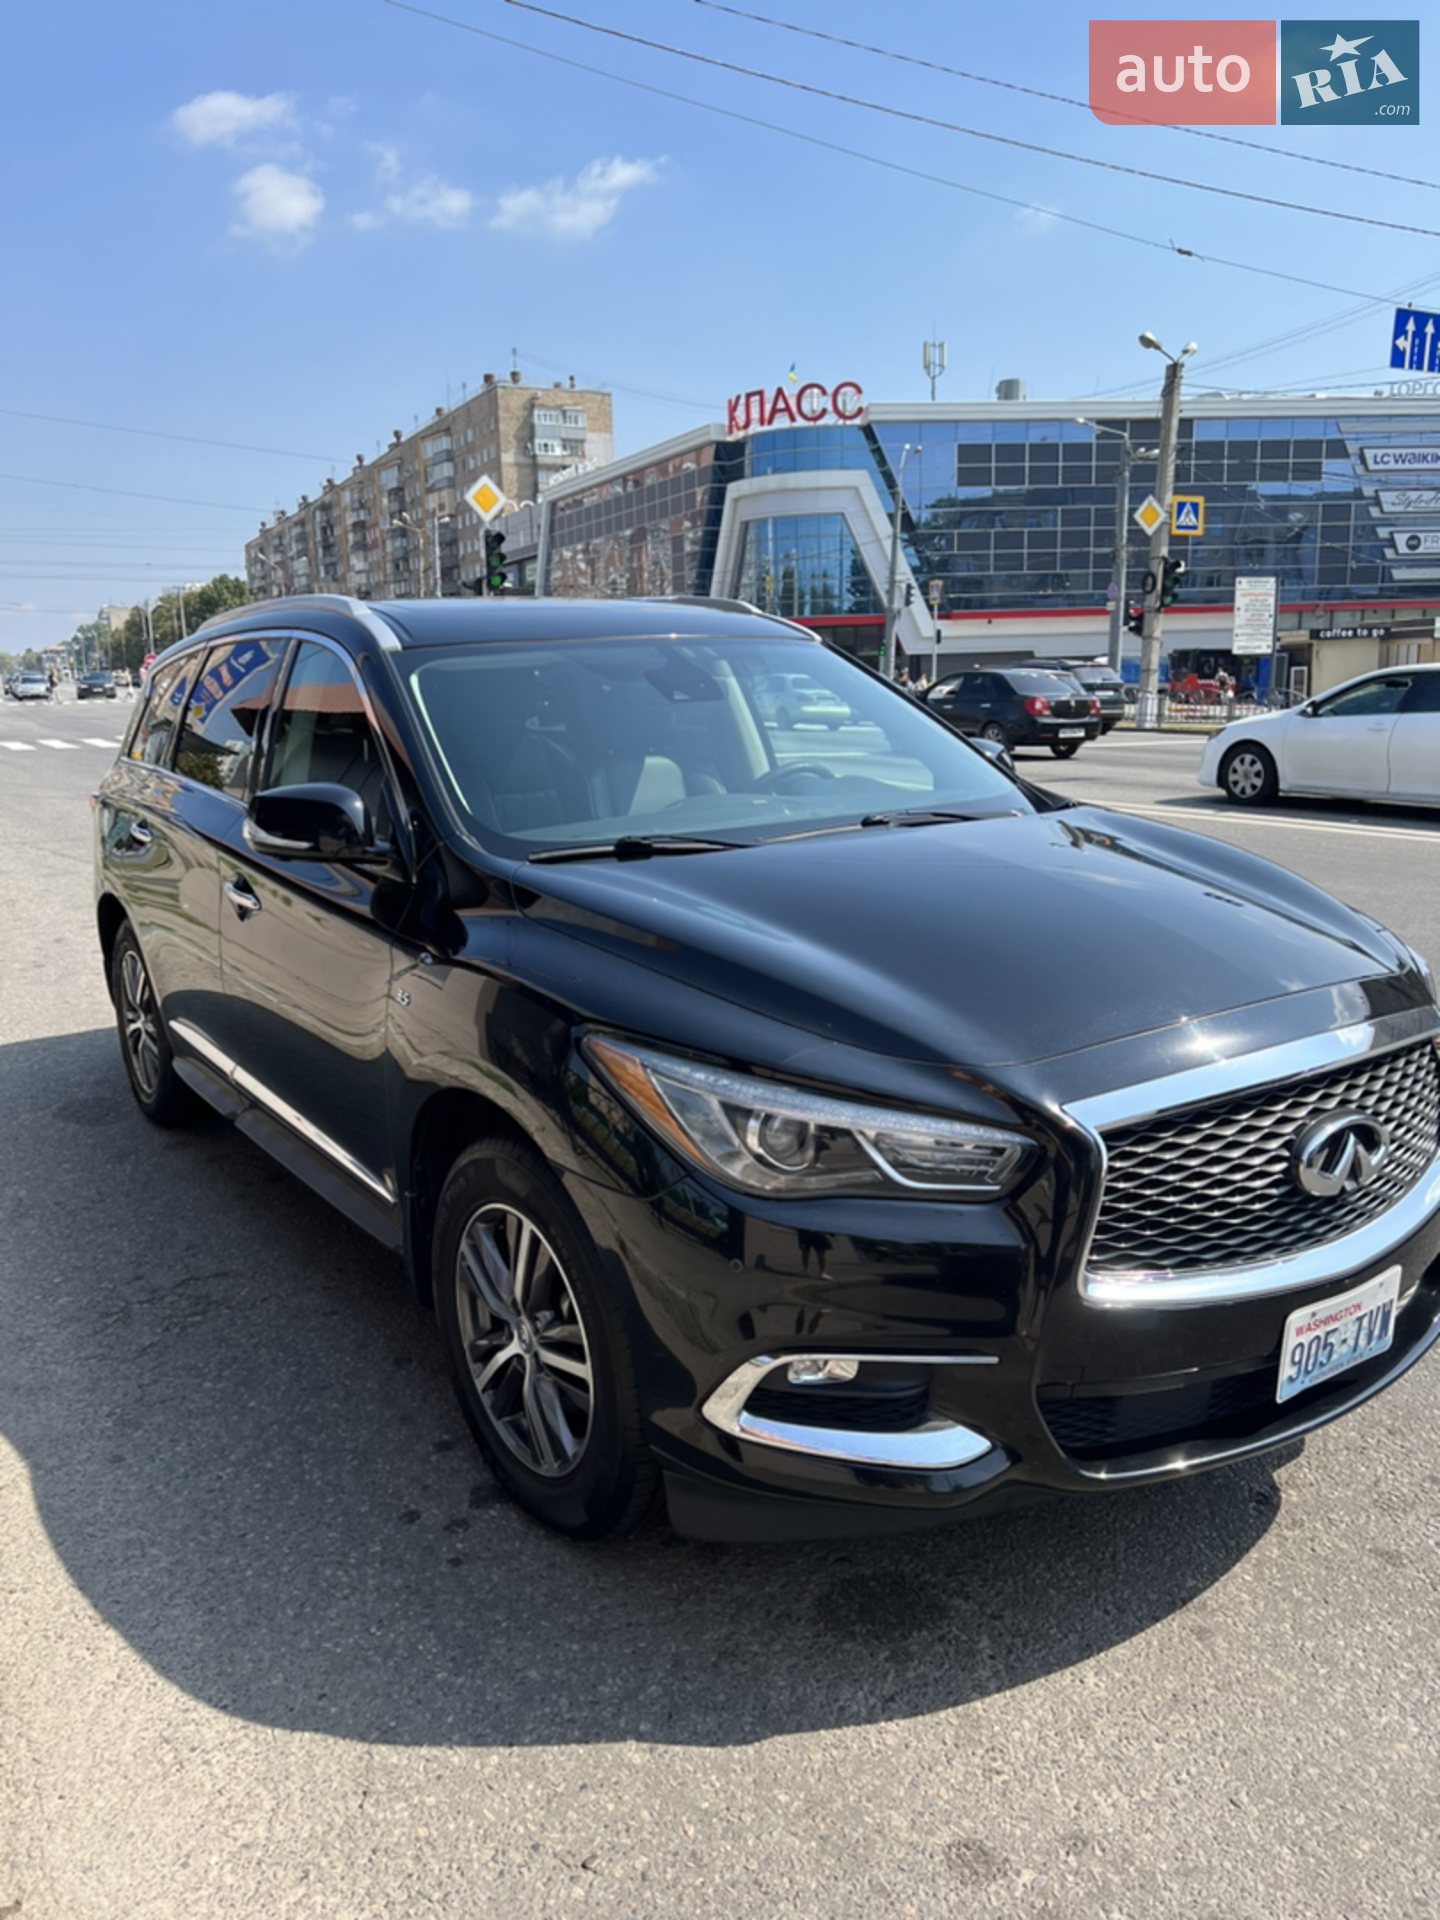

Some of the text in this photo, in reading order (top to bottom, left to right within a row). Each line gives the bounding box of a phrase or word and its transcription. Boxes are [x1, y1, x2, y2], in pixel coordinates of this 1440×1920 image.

[726, 380, 864, 435] КЛАСС
[1373, 452, 1391, 465] LC
[1319, 627, 1386, 639] coffee to go
[1294, 1301, 1364, 1338] WASHINGTON
